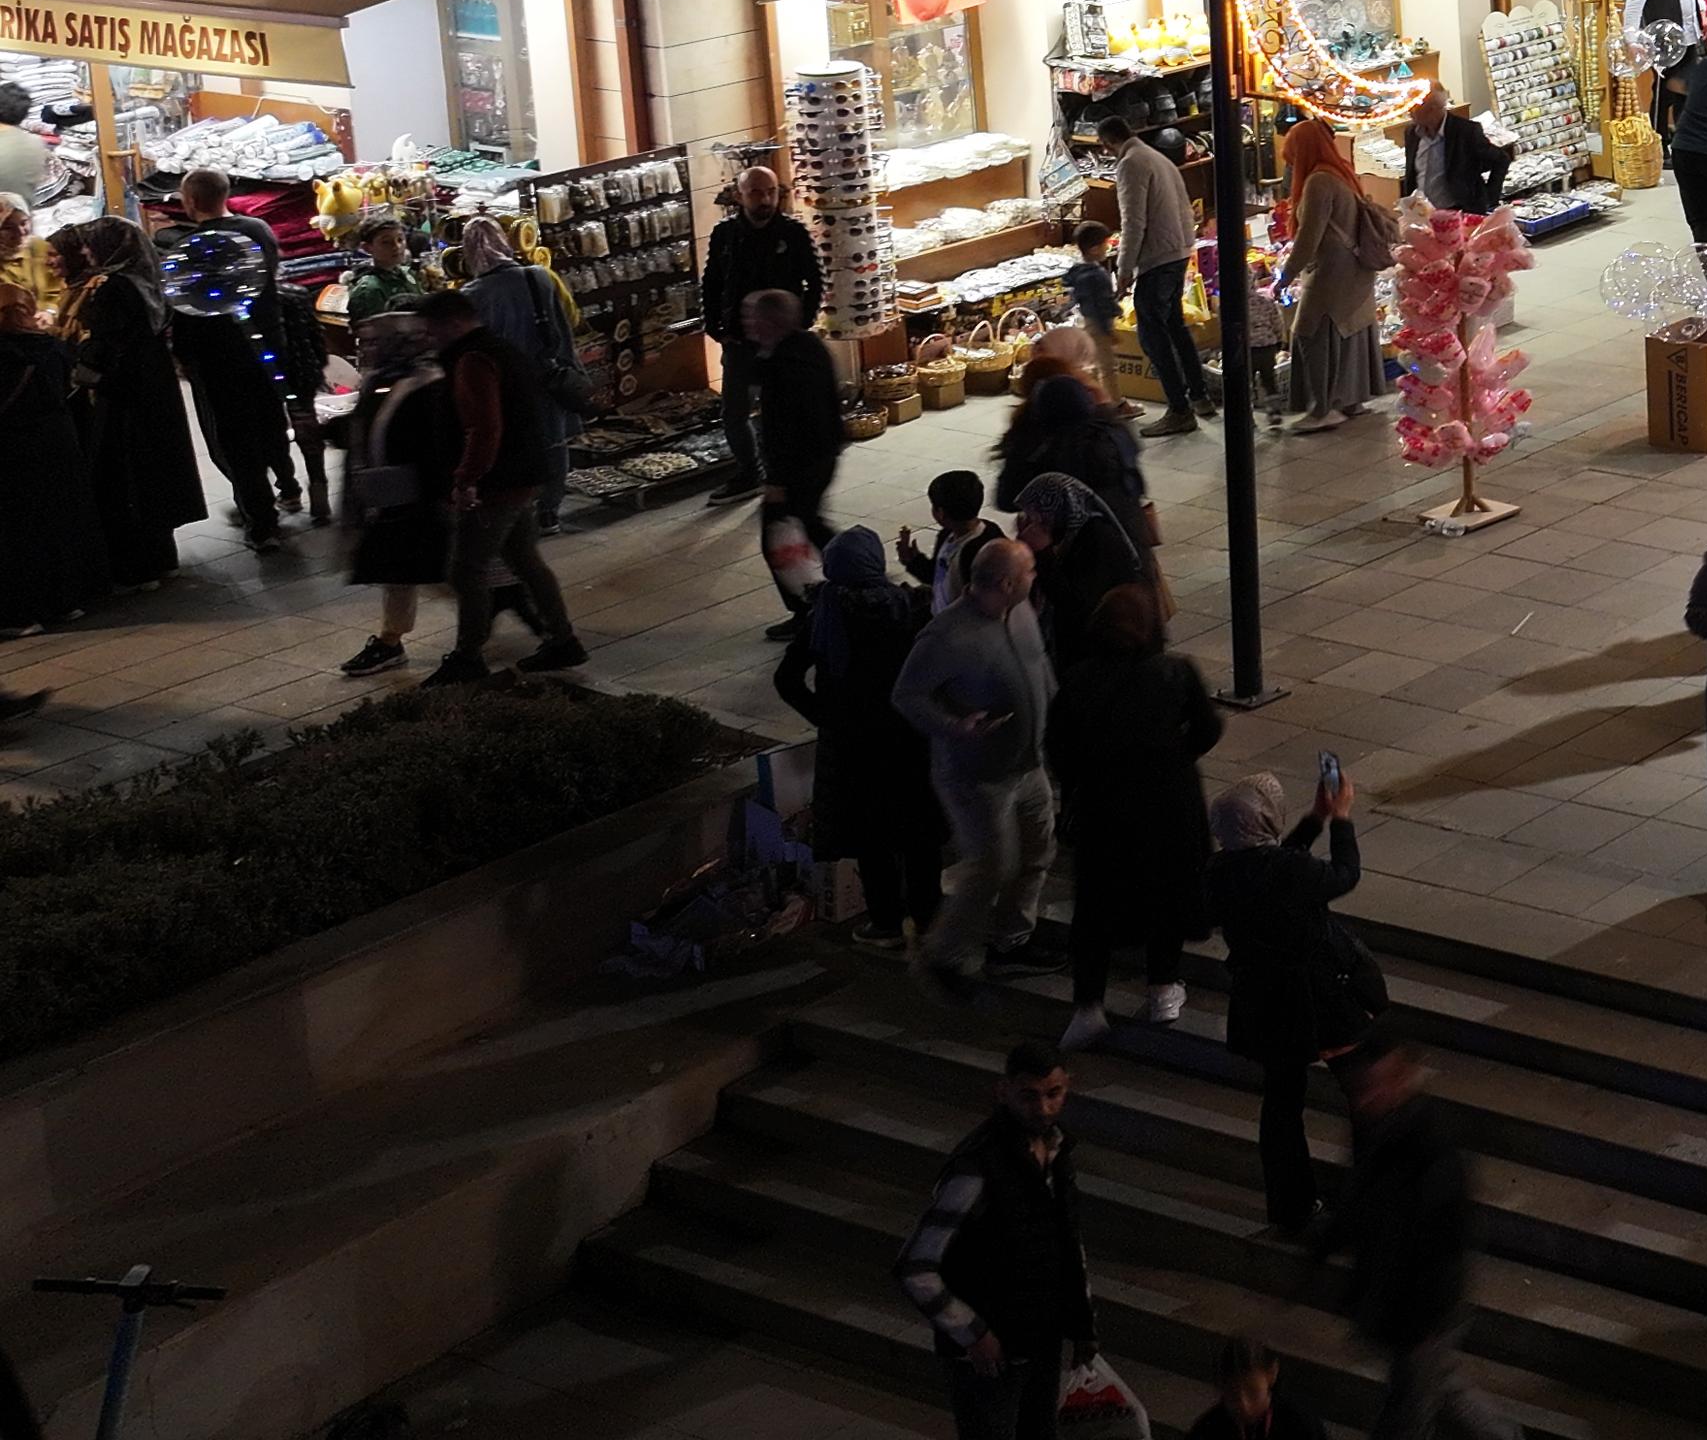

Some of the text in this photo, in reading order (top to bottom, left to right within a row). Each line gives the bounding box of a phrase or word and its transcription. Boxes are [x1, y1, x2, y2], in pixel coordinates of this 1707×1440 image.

[65, 13, 132, 59] SATIŞ
[139, 16, 271, 67] MAĞAZASI
[1675, 372, 1690, 447] BERICAP
